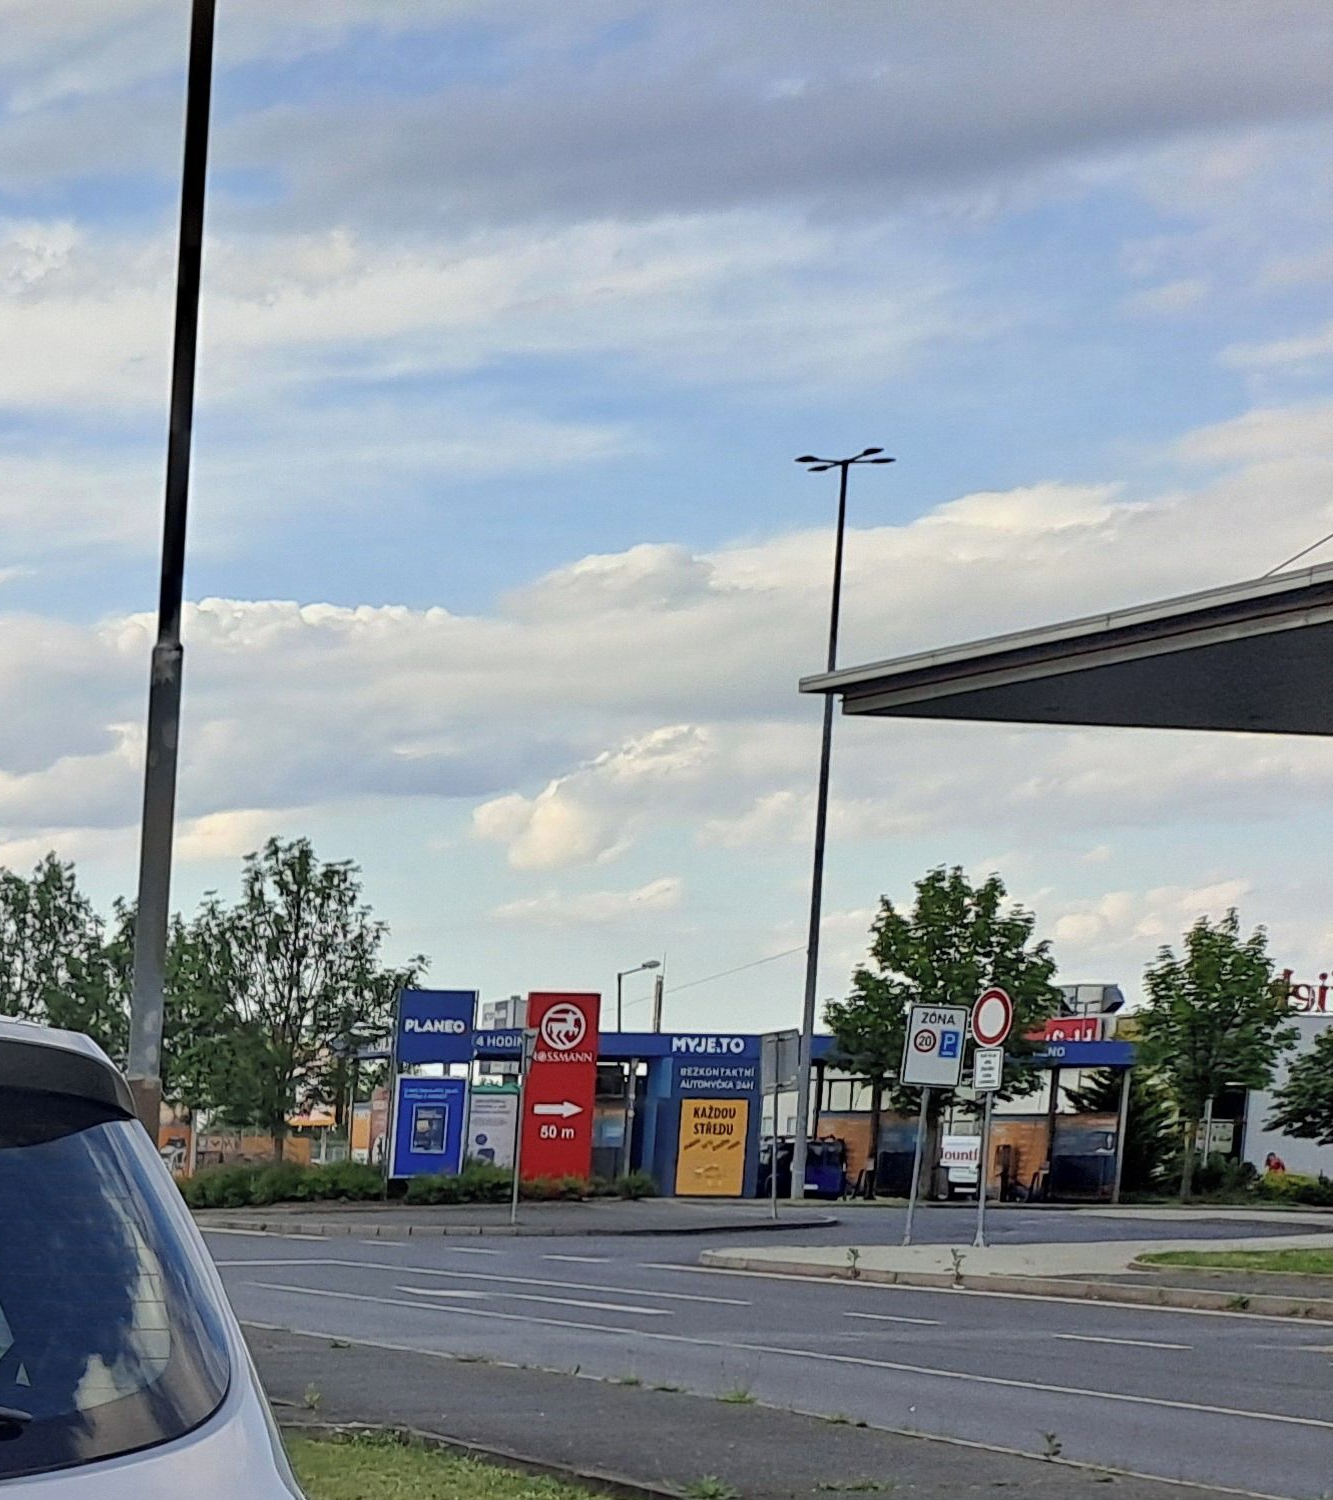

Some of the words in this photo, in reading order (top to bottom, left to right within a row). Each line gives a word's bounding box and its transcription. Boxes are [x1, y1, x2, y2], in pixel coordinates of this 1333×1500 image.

[404, 1018, 465, 1034] PLANEO
[918, 1035, 932, 1047] 20
[944, 1033, 956, 1050] P
[693, 1104, 737, 1120] KAŽDOU
[561, 1127, 574, 1139] m
[693, 1121, 734, 1136] STŘEDU
